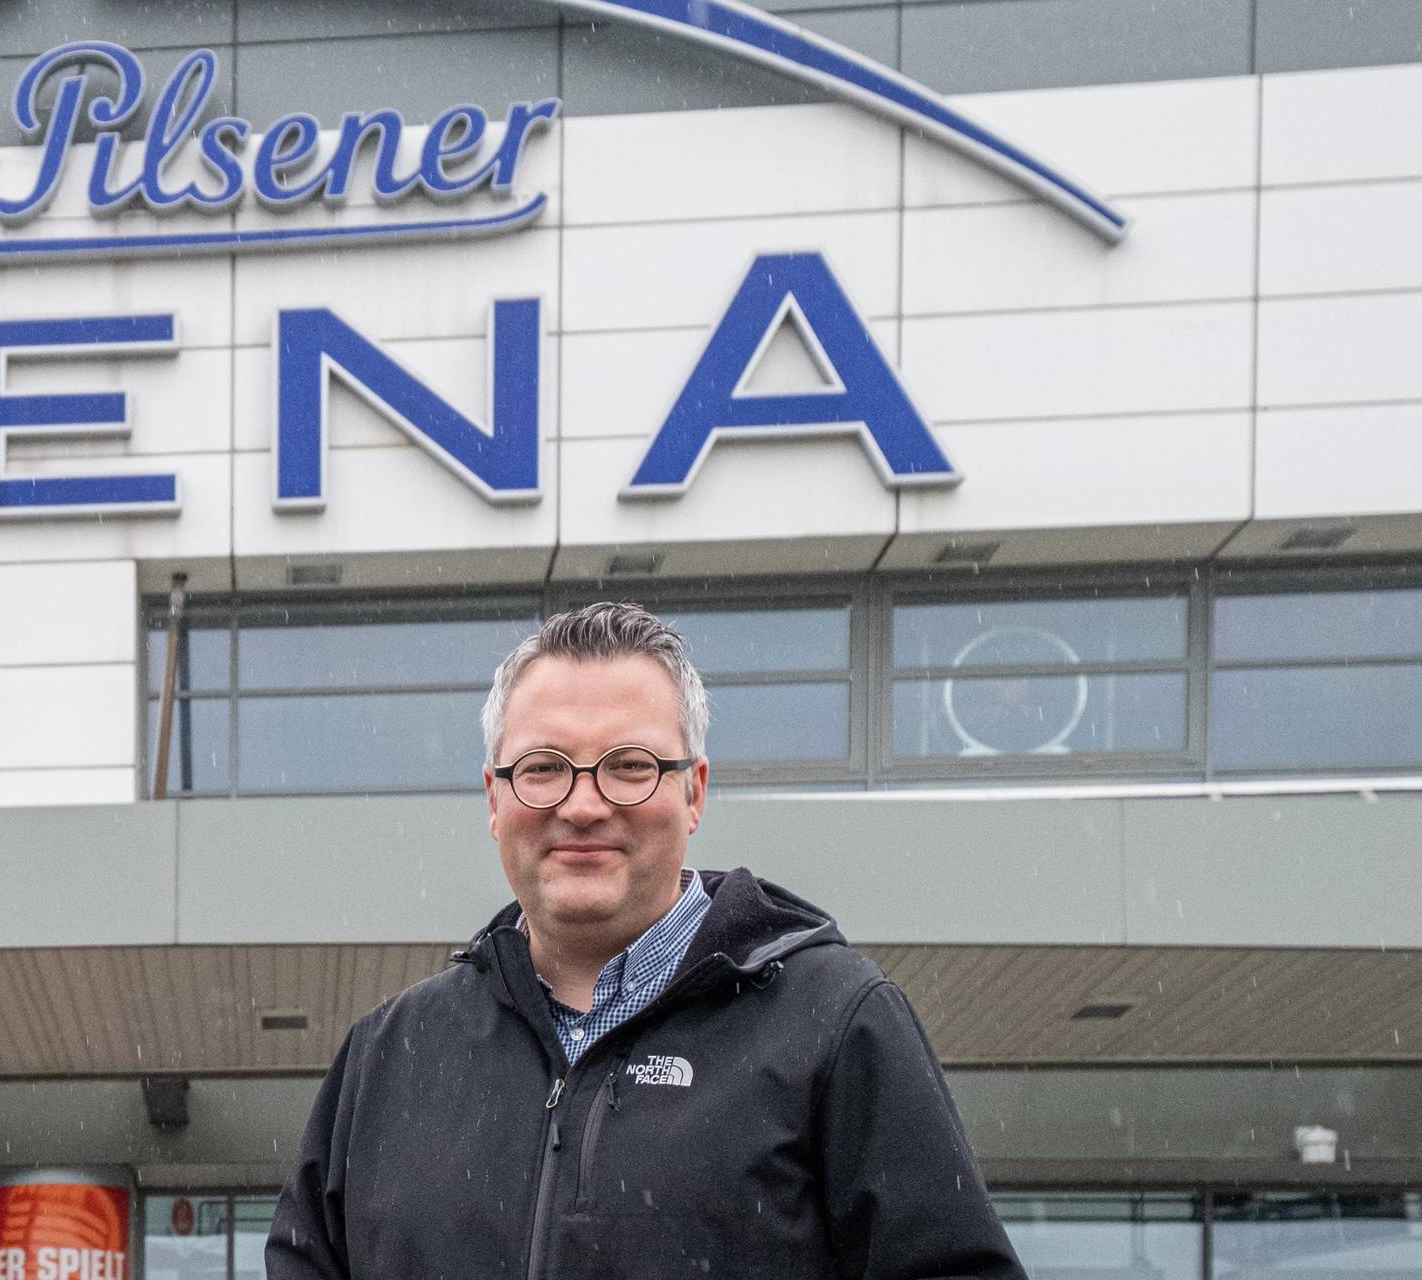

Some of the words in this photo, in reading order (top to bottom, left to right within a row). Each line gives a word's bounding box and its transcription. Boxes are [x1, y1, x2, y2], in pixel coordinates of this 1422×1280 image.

[647, 1055, 674, 1066] THE
[626, 1064, 671, 1075] NORTH
[635, 1074, 669, 1085] FACE
[36, 1247, 125, 1280] SPIELT
